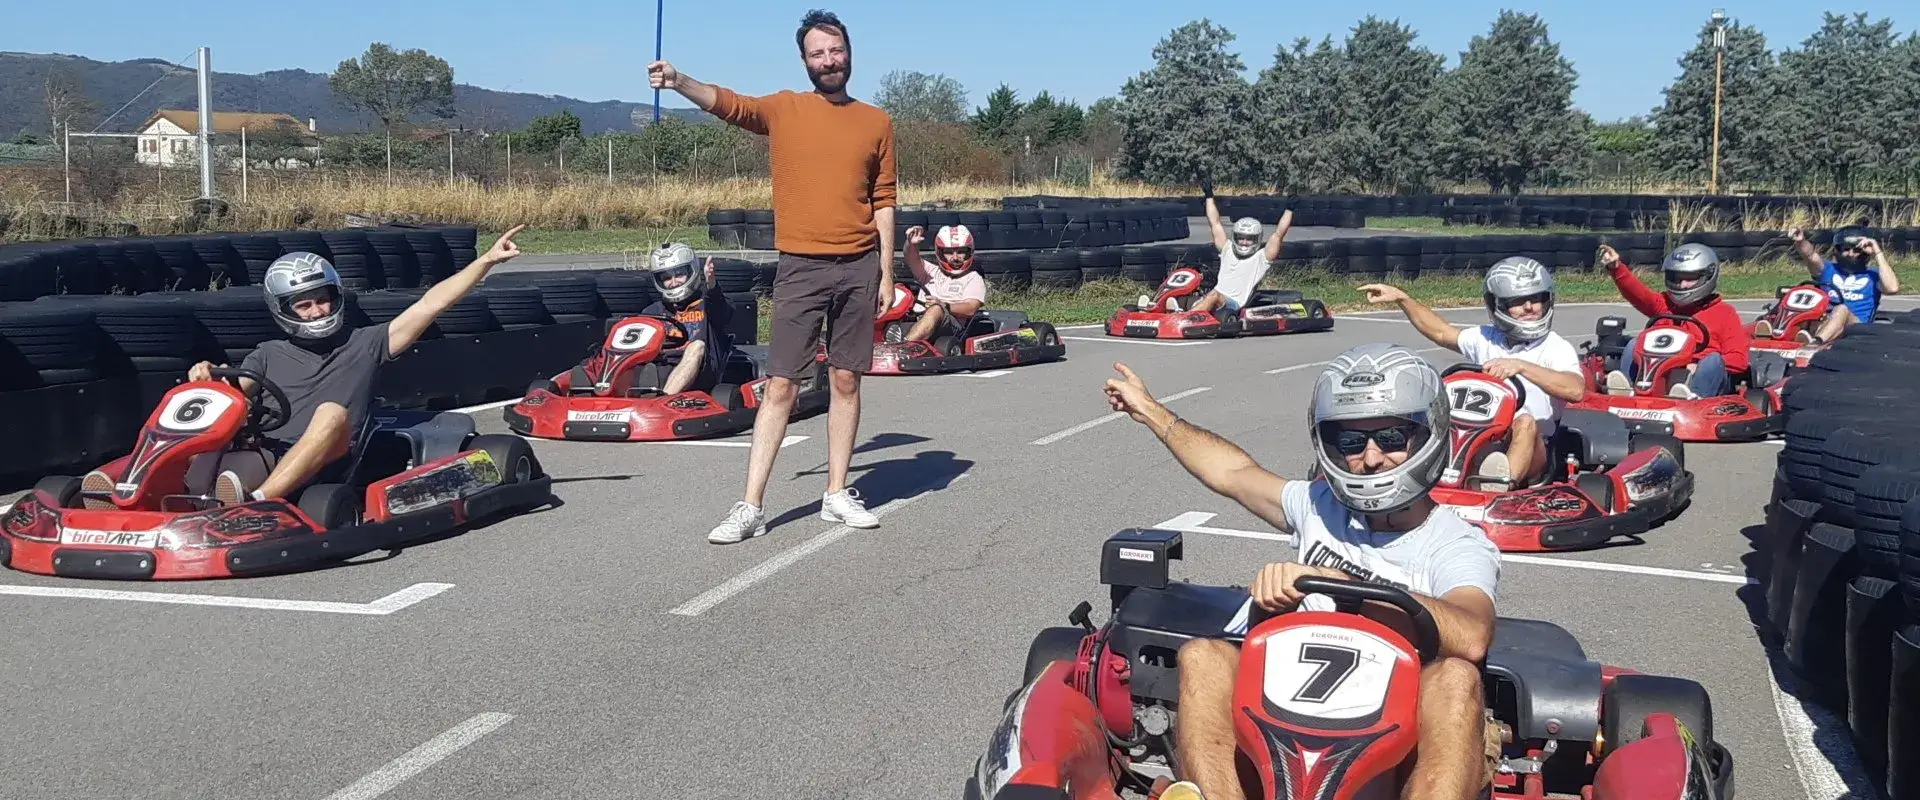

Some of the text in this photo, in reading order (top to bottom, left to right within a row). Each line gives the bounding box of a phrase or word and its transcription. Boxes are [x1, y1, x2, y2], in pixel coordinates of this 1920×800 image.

[1793, 293, 1815, 305] 11
[620, 327, 645, 346] 5
[1654, 334, 1675, 349] 9
[174, 396, 213, 424] 6
[1451, 386, 1494, 417] 12
[71, 529, 146, 546] birelART
[1290, 642, 1361, 704] 7
